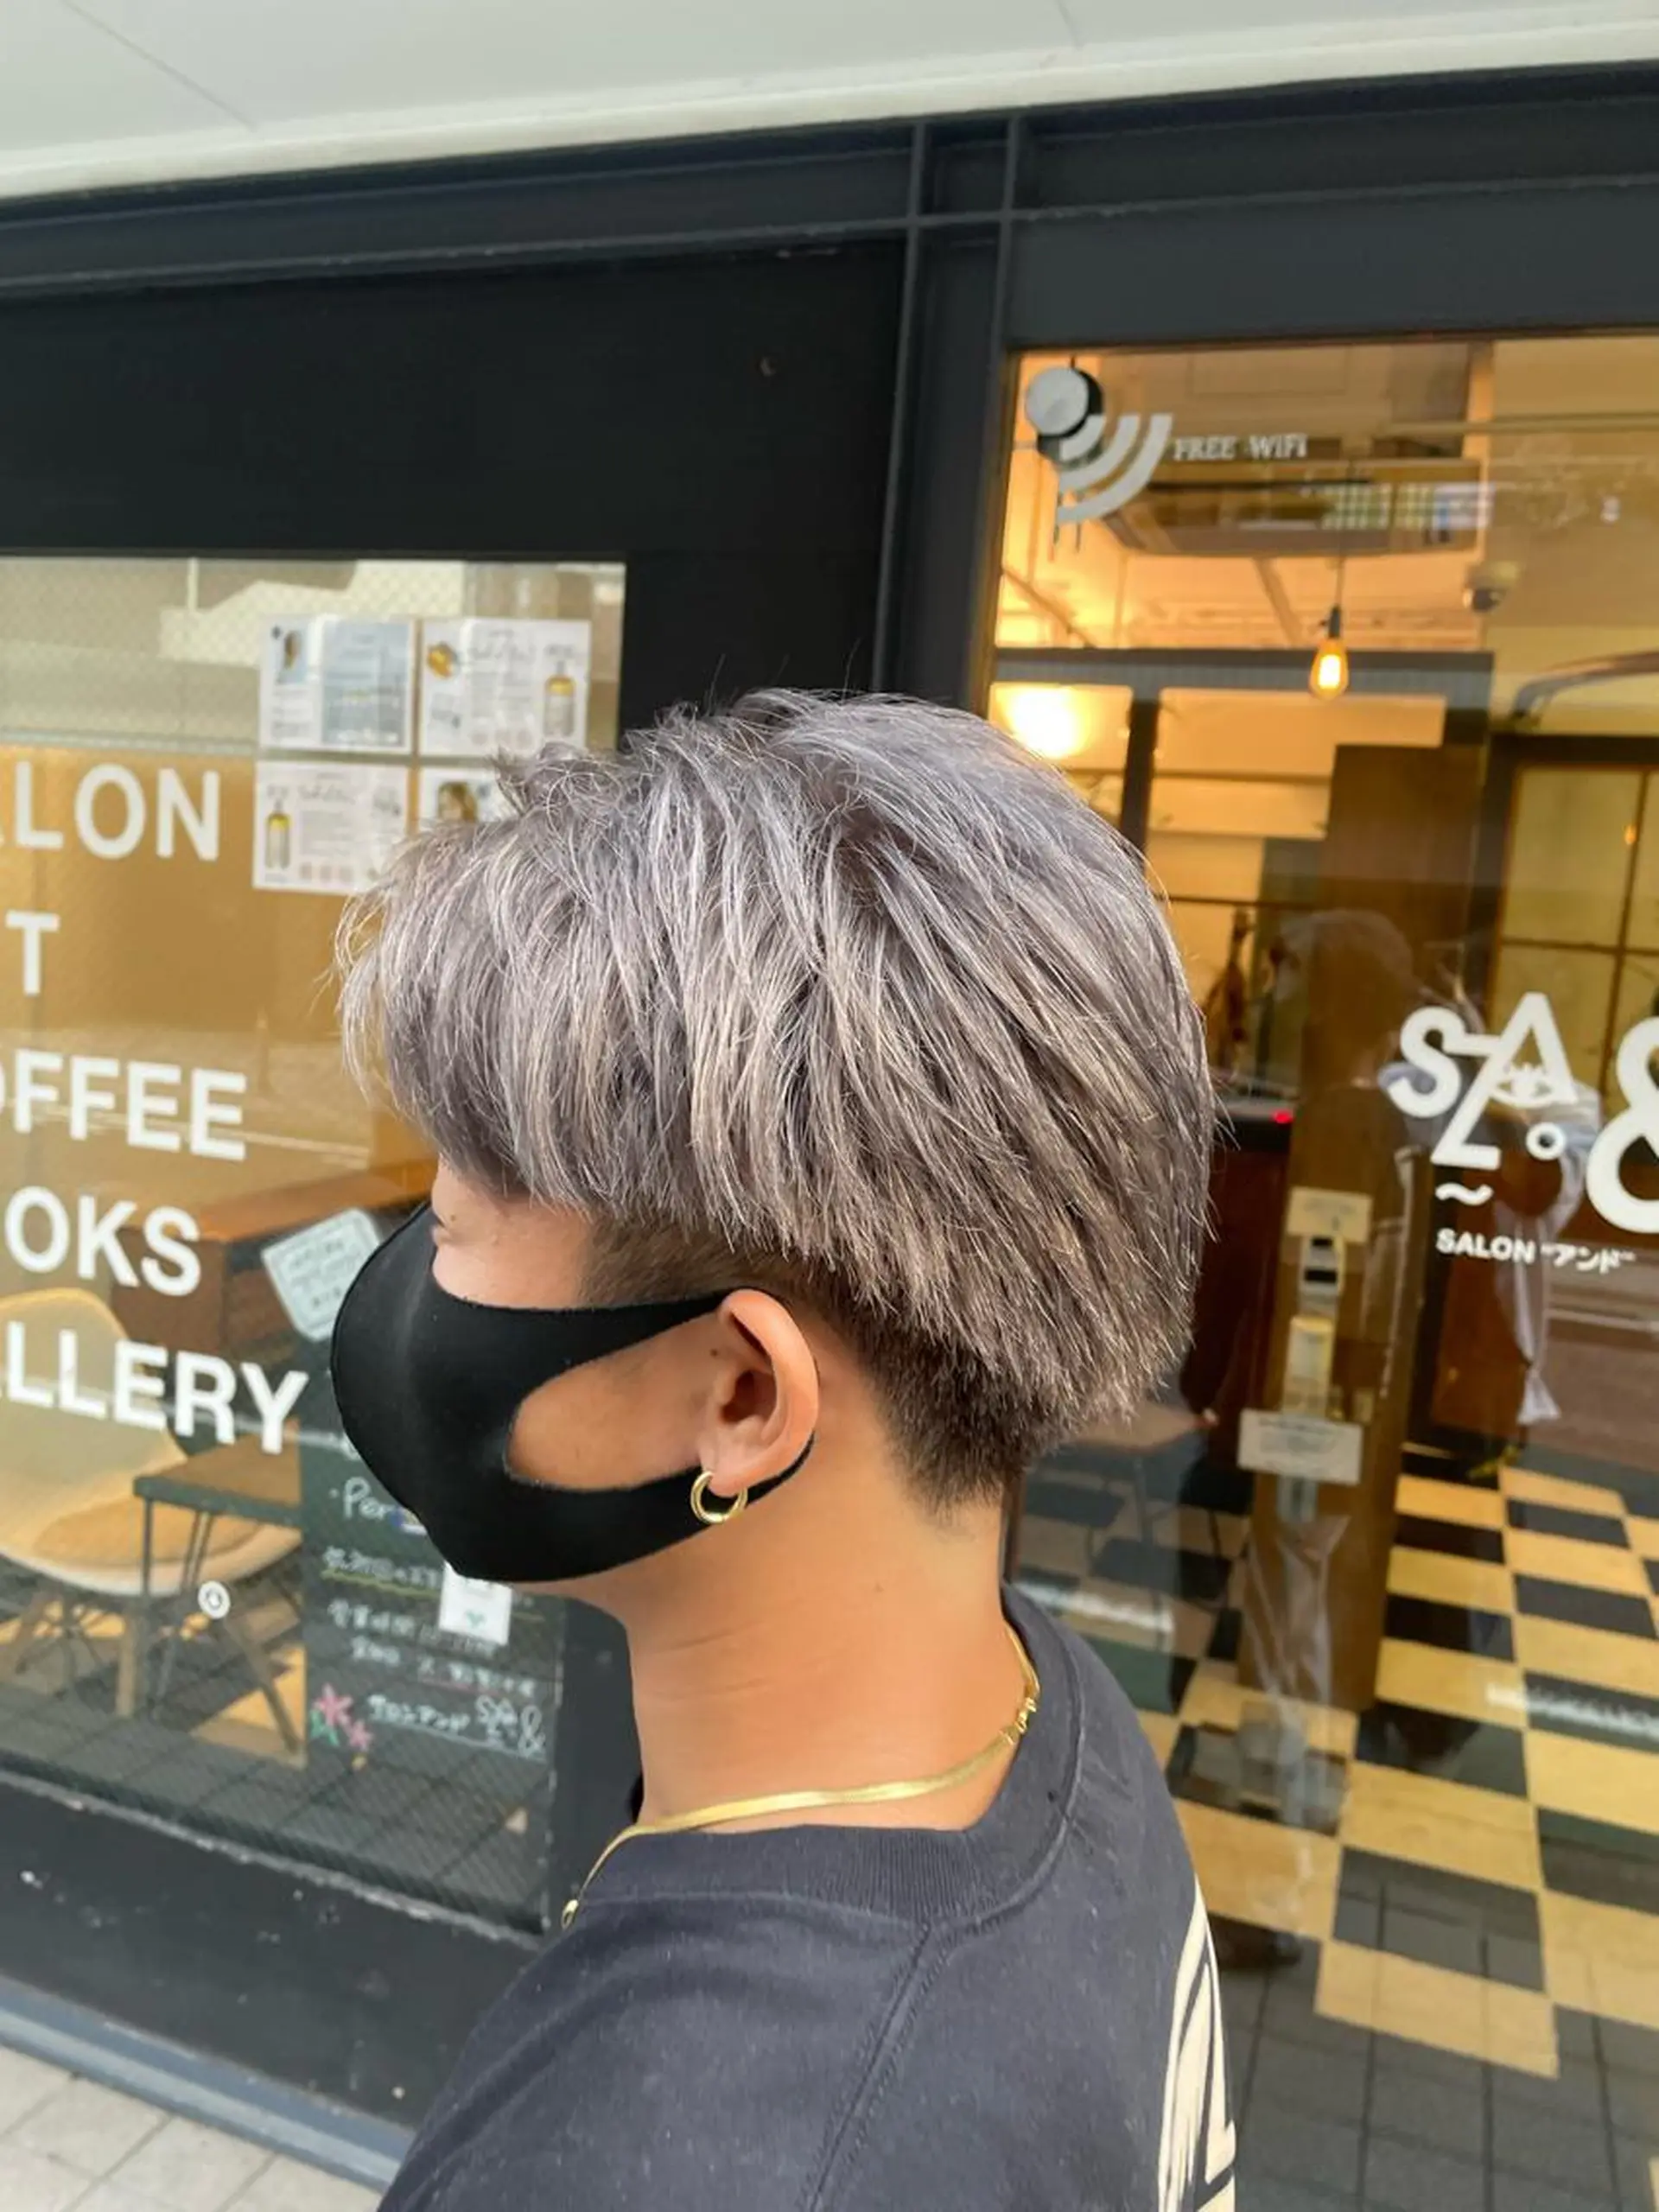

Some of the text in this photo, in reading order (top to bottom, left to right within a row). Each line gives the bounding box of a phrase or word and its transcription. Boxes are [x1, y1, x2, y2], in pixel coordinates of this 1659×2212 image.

[1173, 435, 1238, 461] FREE
[0, 760, 221, 862] LON
[0, 1048, 248, 1161] FFEE
[1435, 1227, 1536, 1265] SALON
[0, 1320, 308, 1456] LLERY
